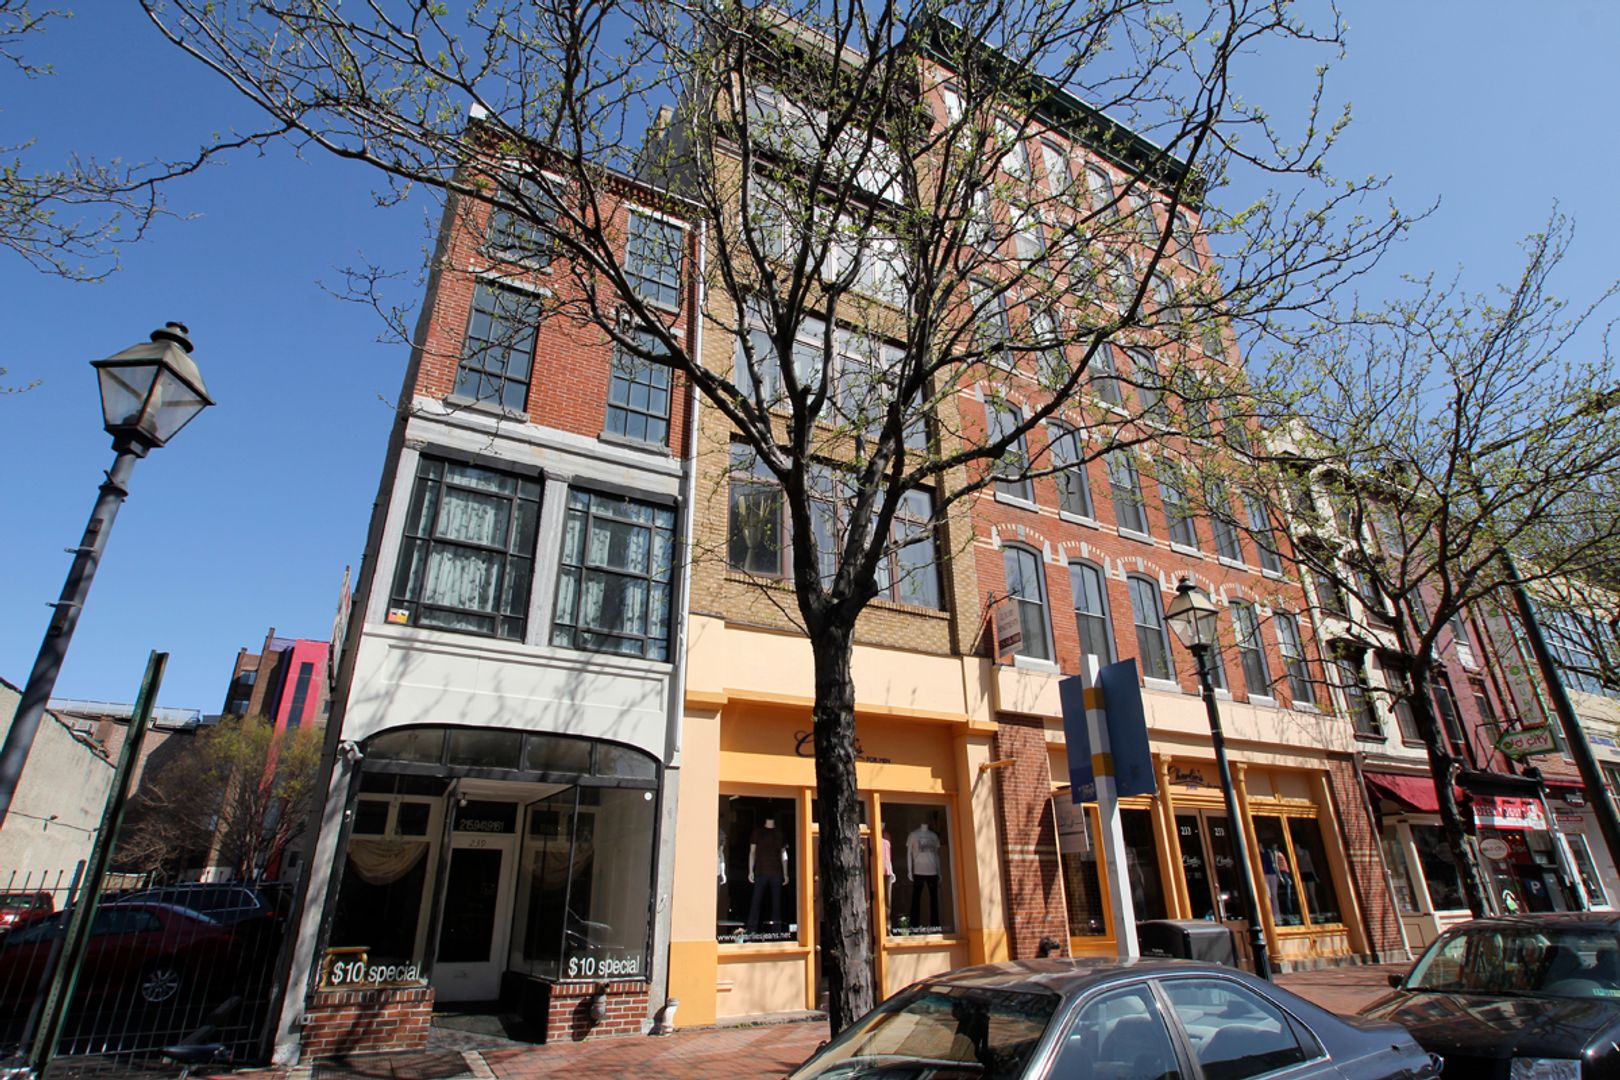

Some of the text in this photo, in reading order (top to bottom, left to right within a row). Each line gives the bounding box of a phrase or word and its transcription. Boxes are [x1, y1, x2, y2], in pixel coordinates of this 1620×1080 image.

[1526, 731, 1550, 747] city
[331, 960, 421, 987] $10 special
[568, 955, 640, 979] $10 special
